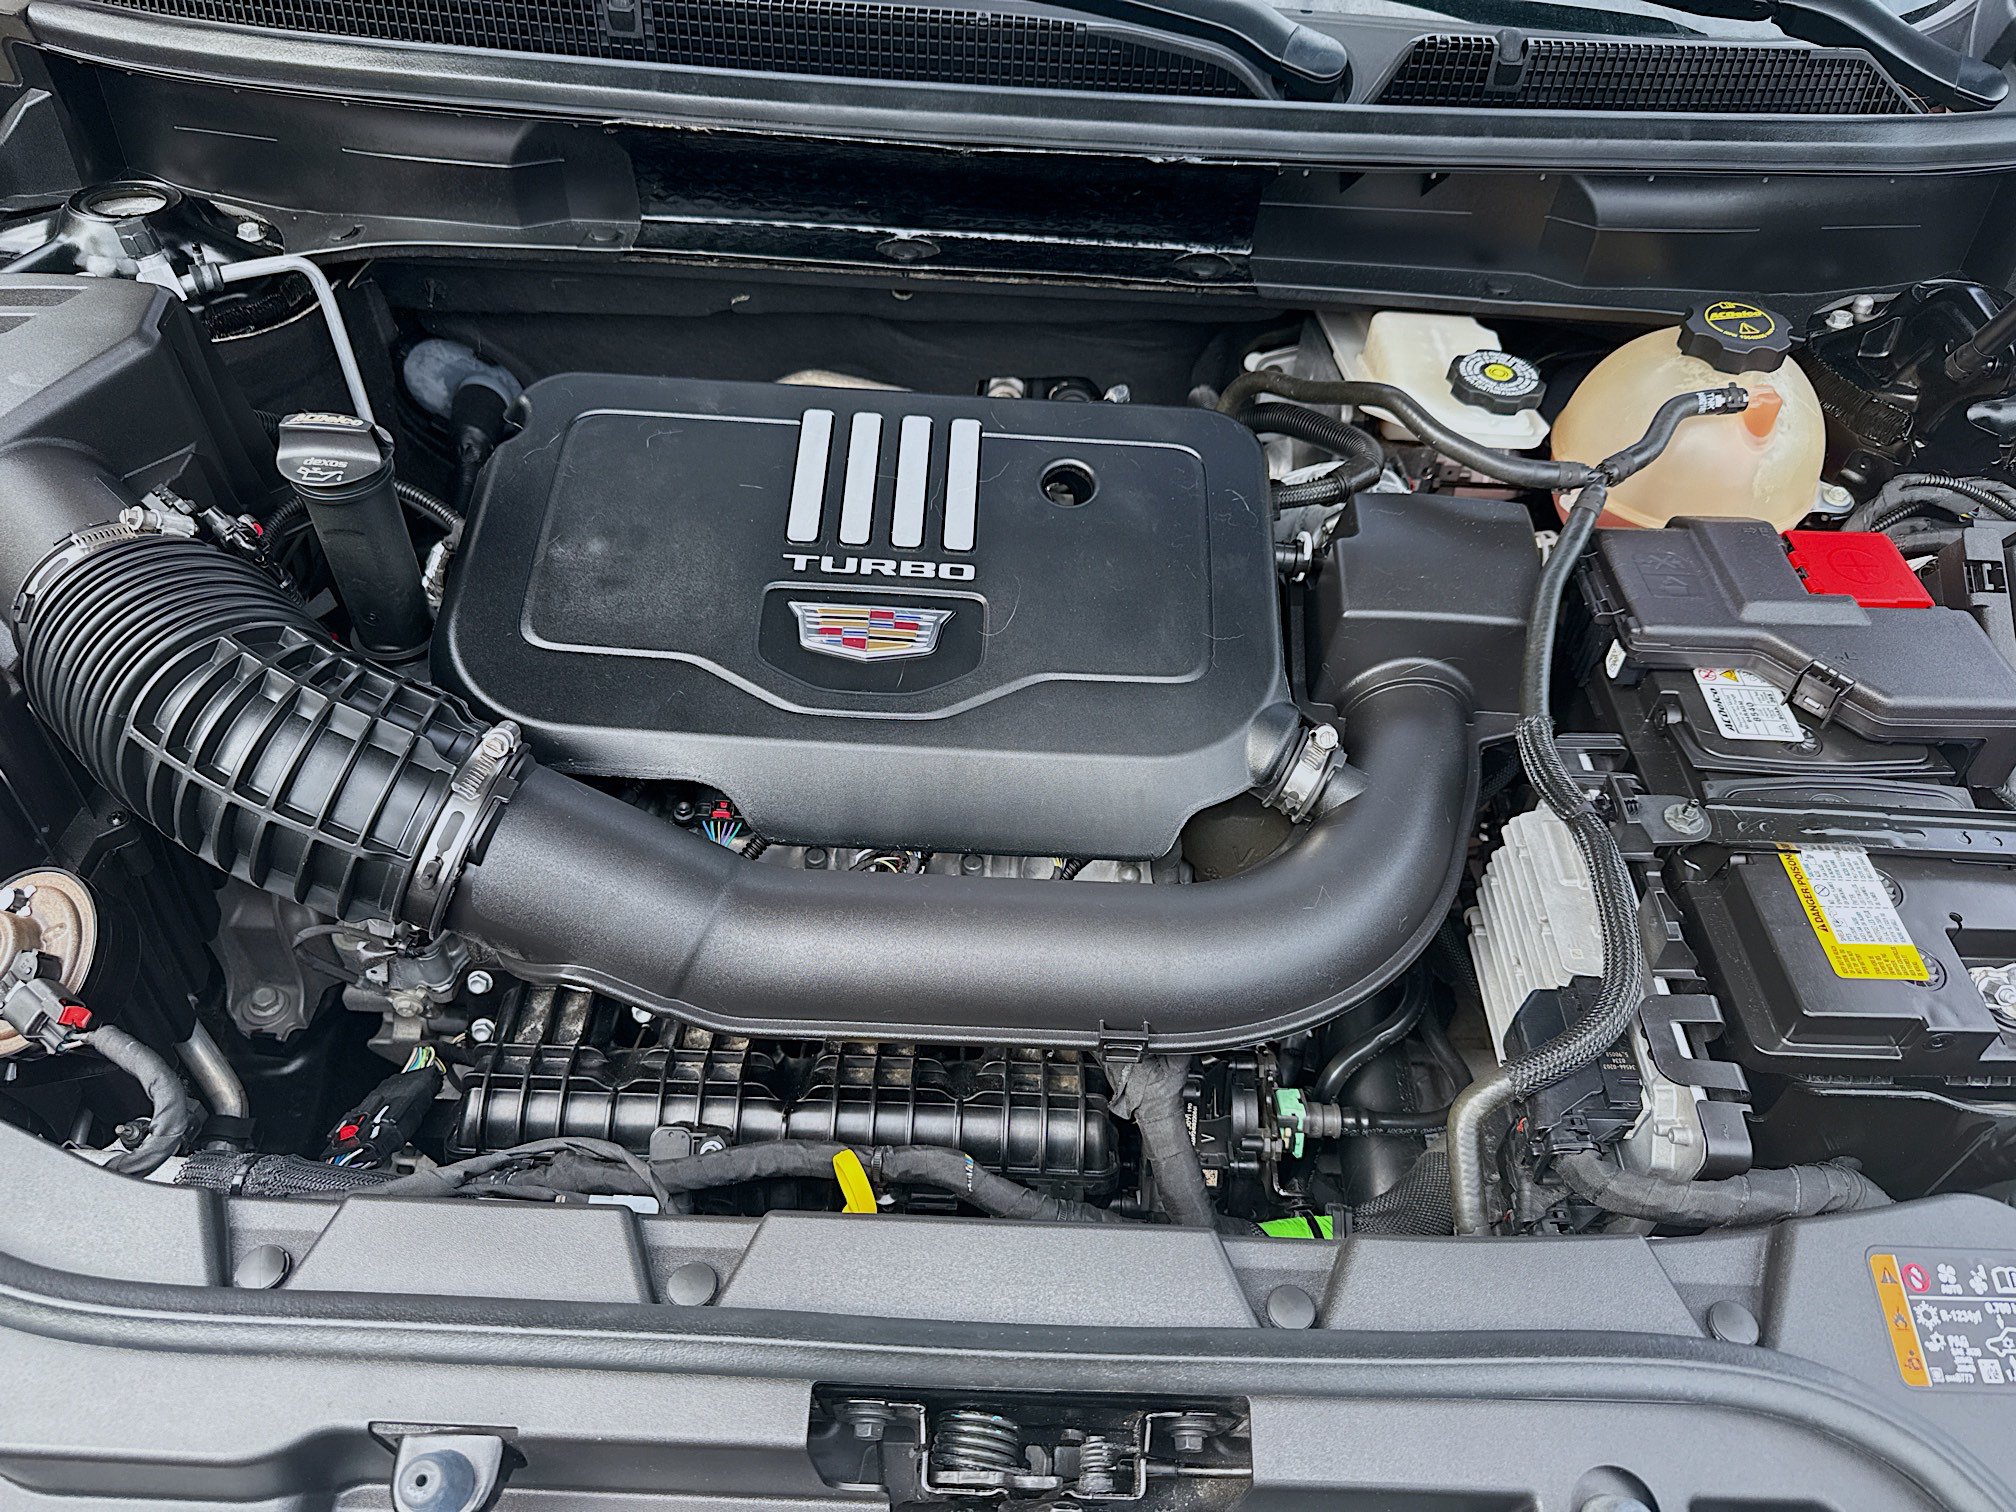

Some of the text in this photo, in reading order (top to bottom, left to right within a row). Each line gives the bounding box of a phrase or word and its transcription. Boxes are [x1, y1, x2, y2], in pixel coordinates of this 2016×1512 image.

[303, 457, 348, 468] dexos
[782, 553, 976, 581] TURBO
[1710, 688, 1735, 732] ACDelco
[1746, 702, 1761, 722] 8540
